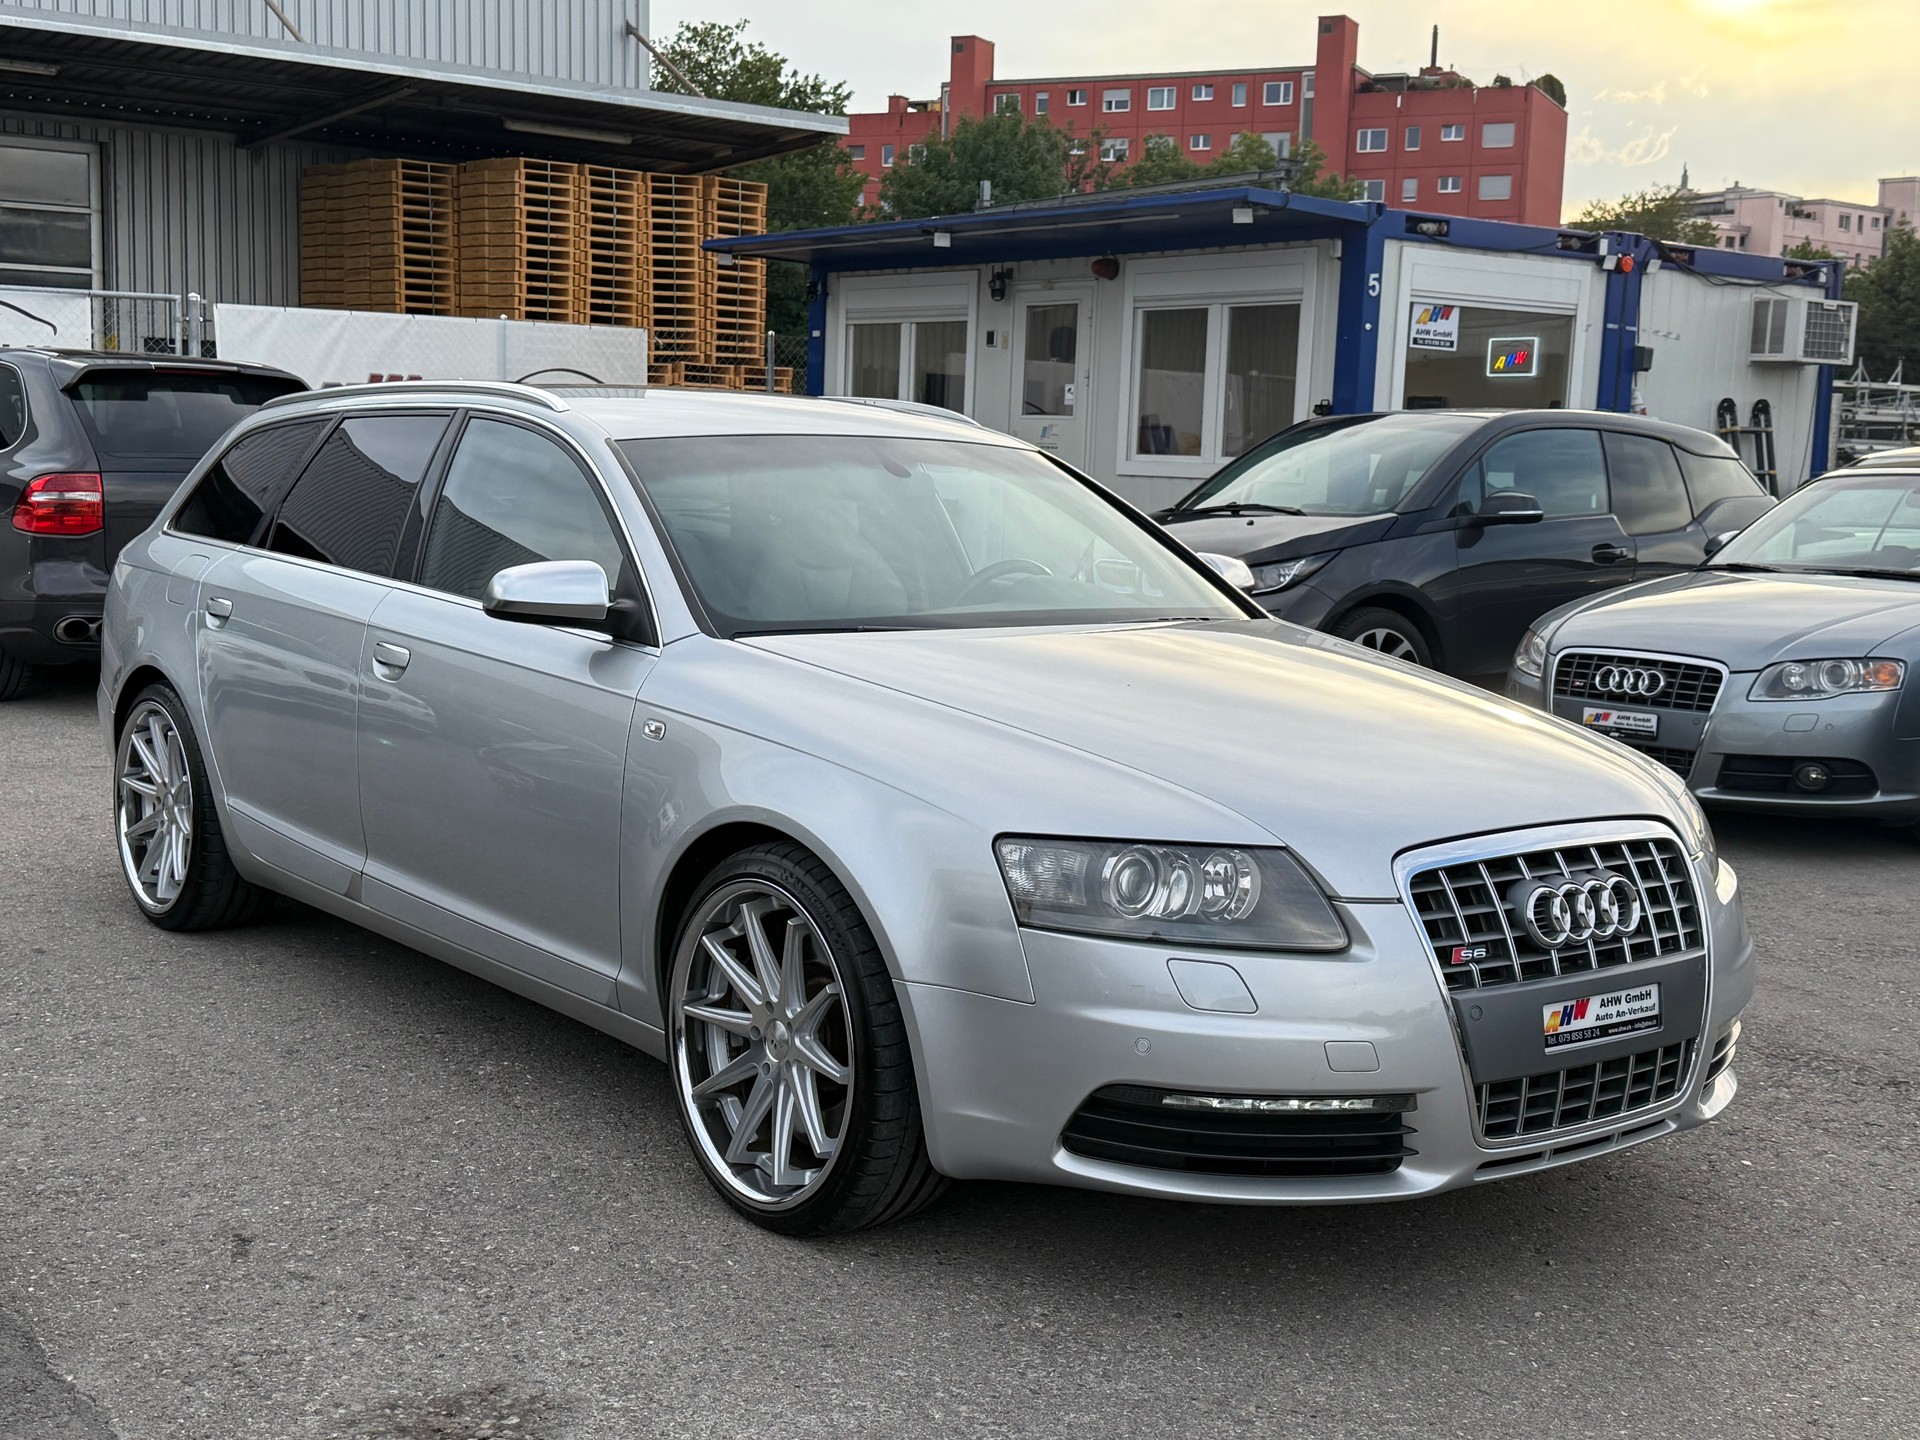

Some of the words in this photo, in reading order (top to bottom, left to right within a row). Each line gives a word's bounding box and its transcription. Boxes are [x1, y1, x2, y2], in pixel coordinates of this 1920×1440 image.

[1368, 273, 1380, 297] 5
[1415, 305, 1454, 325] AHW
[1416, 328, 1431, 336] AHW
[1432, 330, 1452, 338] GmbH
[1494, 351, 1528, 370] AHW
[1585, 711, 1612, 724] AHW
[802, 886, 836, 931] MICHELIN
[1460, 948, 1486, 960] S6
[1600, 995, 1622, 1008] AHW
[1625, 989, 1652, 1003] GmbH
[1544, 997, 1591, 1034] AHW
[1595, 1012, 1614, 1022] Auto
[1616, 1002, 1656, 1018] An-Verkauf
[1547, 1036, 1557, 1045] Tel.
[1558, 1033, 1571, 1043] 079
[1571, 1031, 1583, 1041] 858
[1583, 1029, 1592, 1039] 58
[1592, 1028, 1600, 1037] 24
